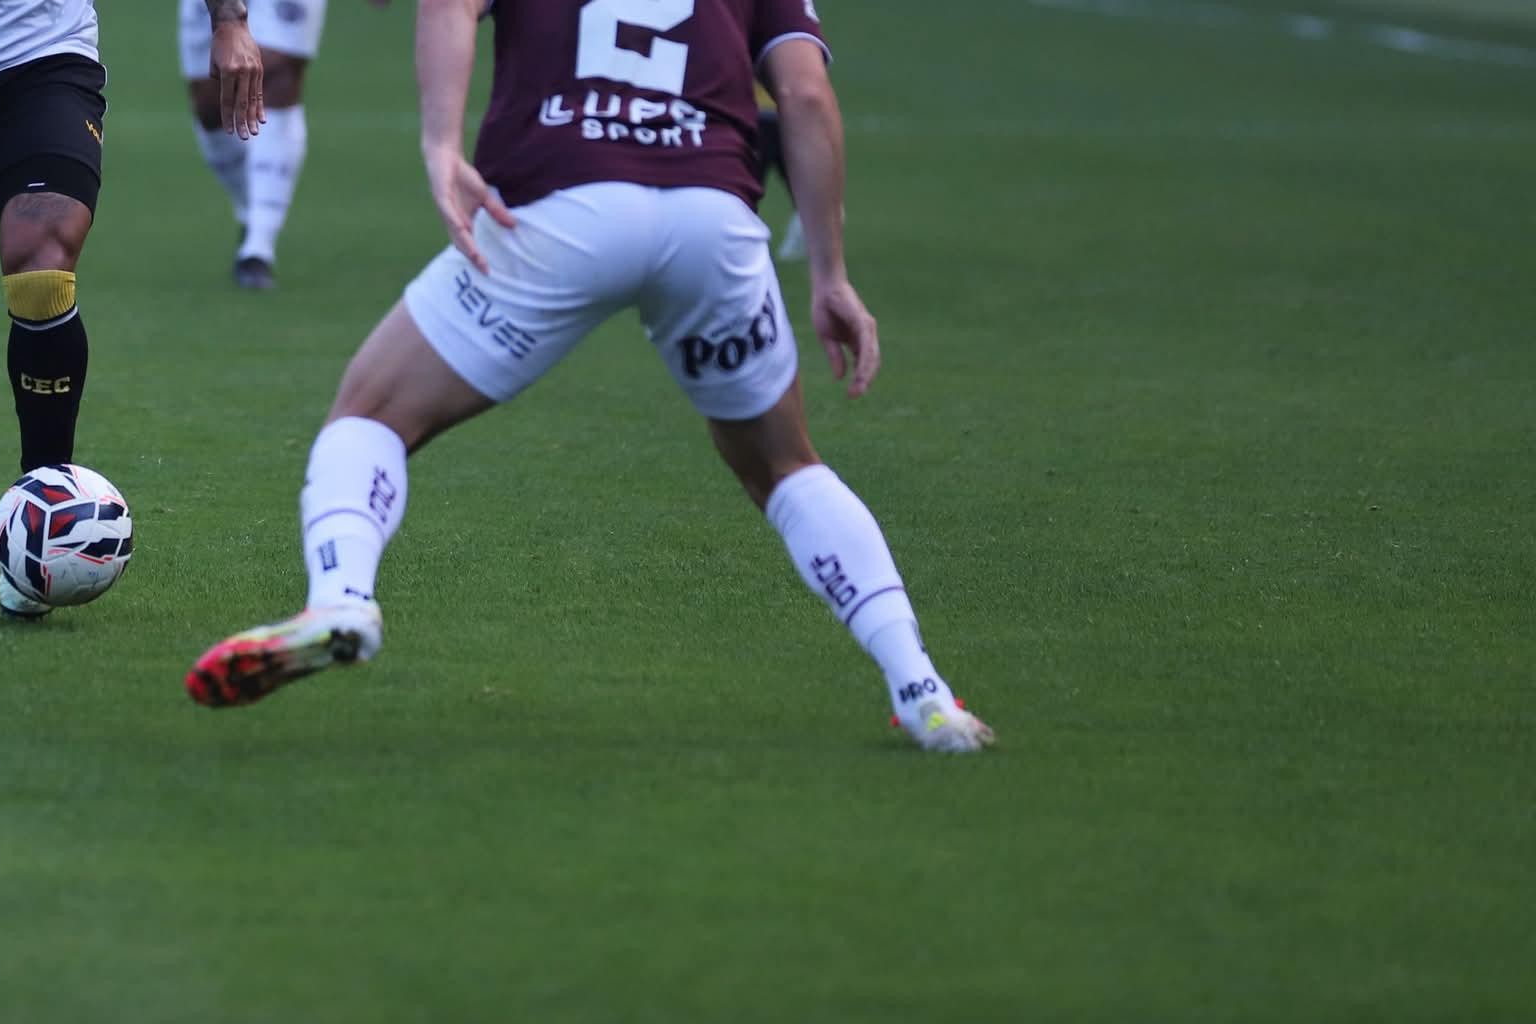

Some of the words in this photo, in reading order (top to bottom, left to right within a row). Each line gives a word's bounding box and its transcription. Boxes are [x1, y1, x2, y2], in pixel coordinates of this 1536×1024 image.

[538, 88, 707, 130] LUPO
[580, 117, 705, 148] SPORT
[20, 372, 71, 395] CEC
